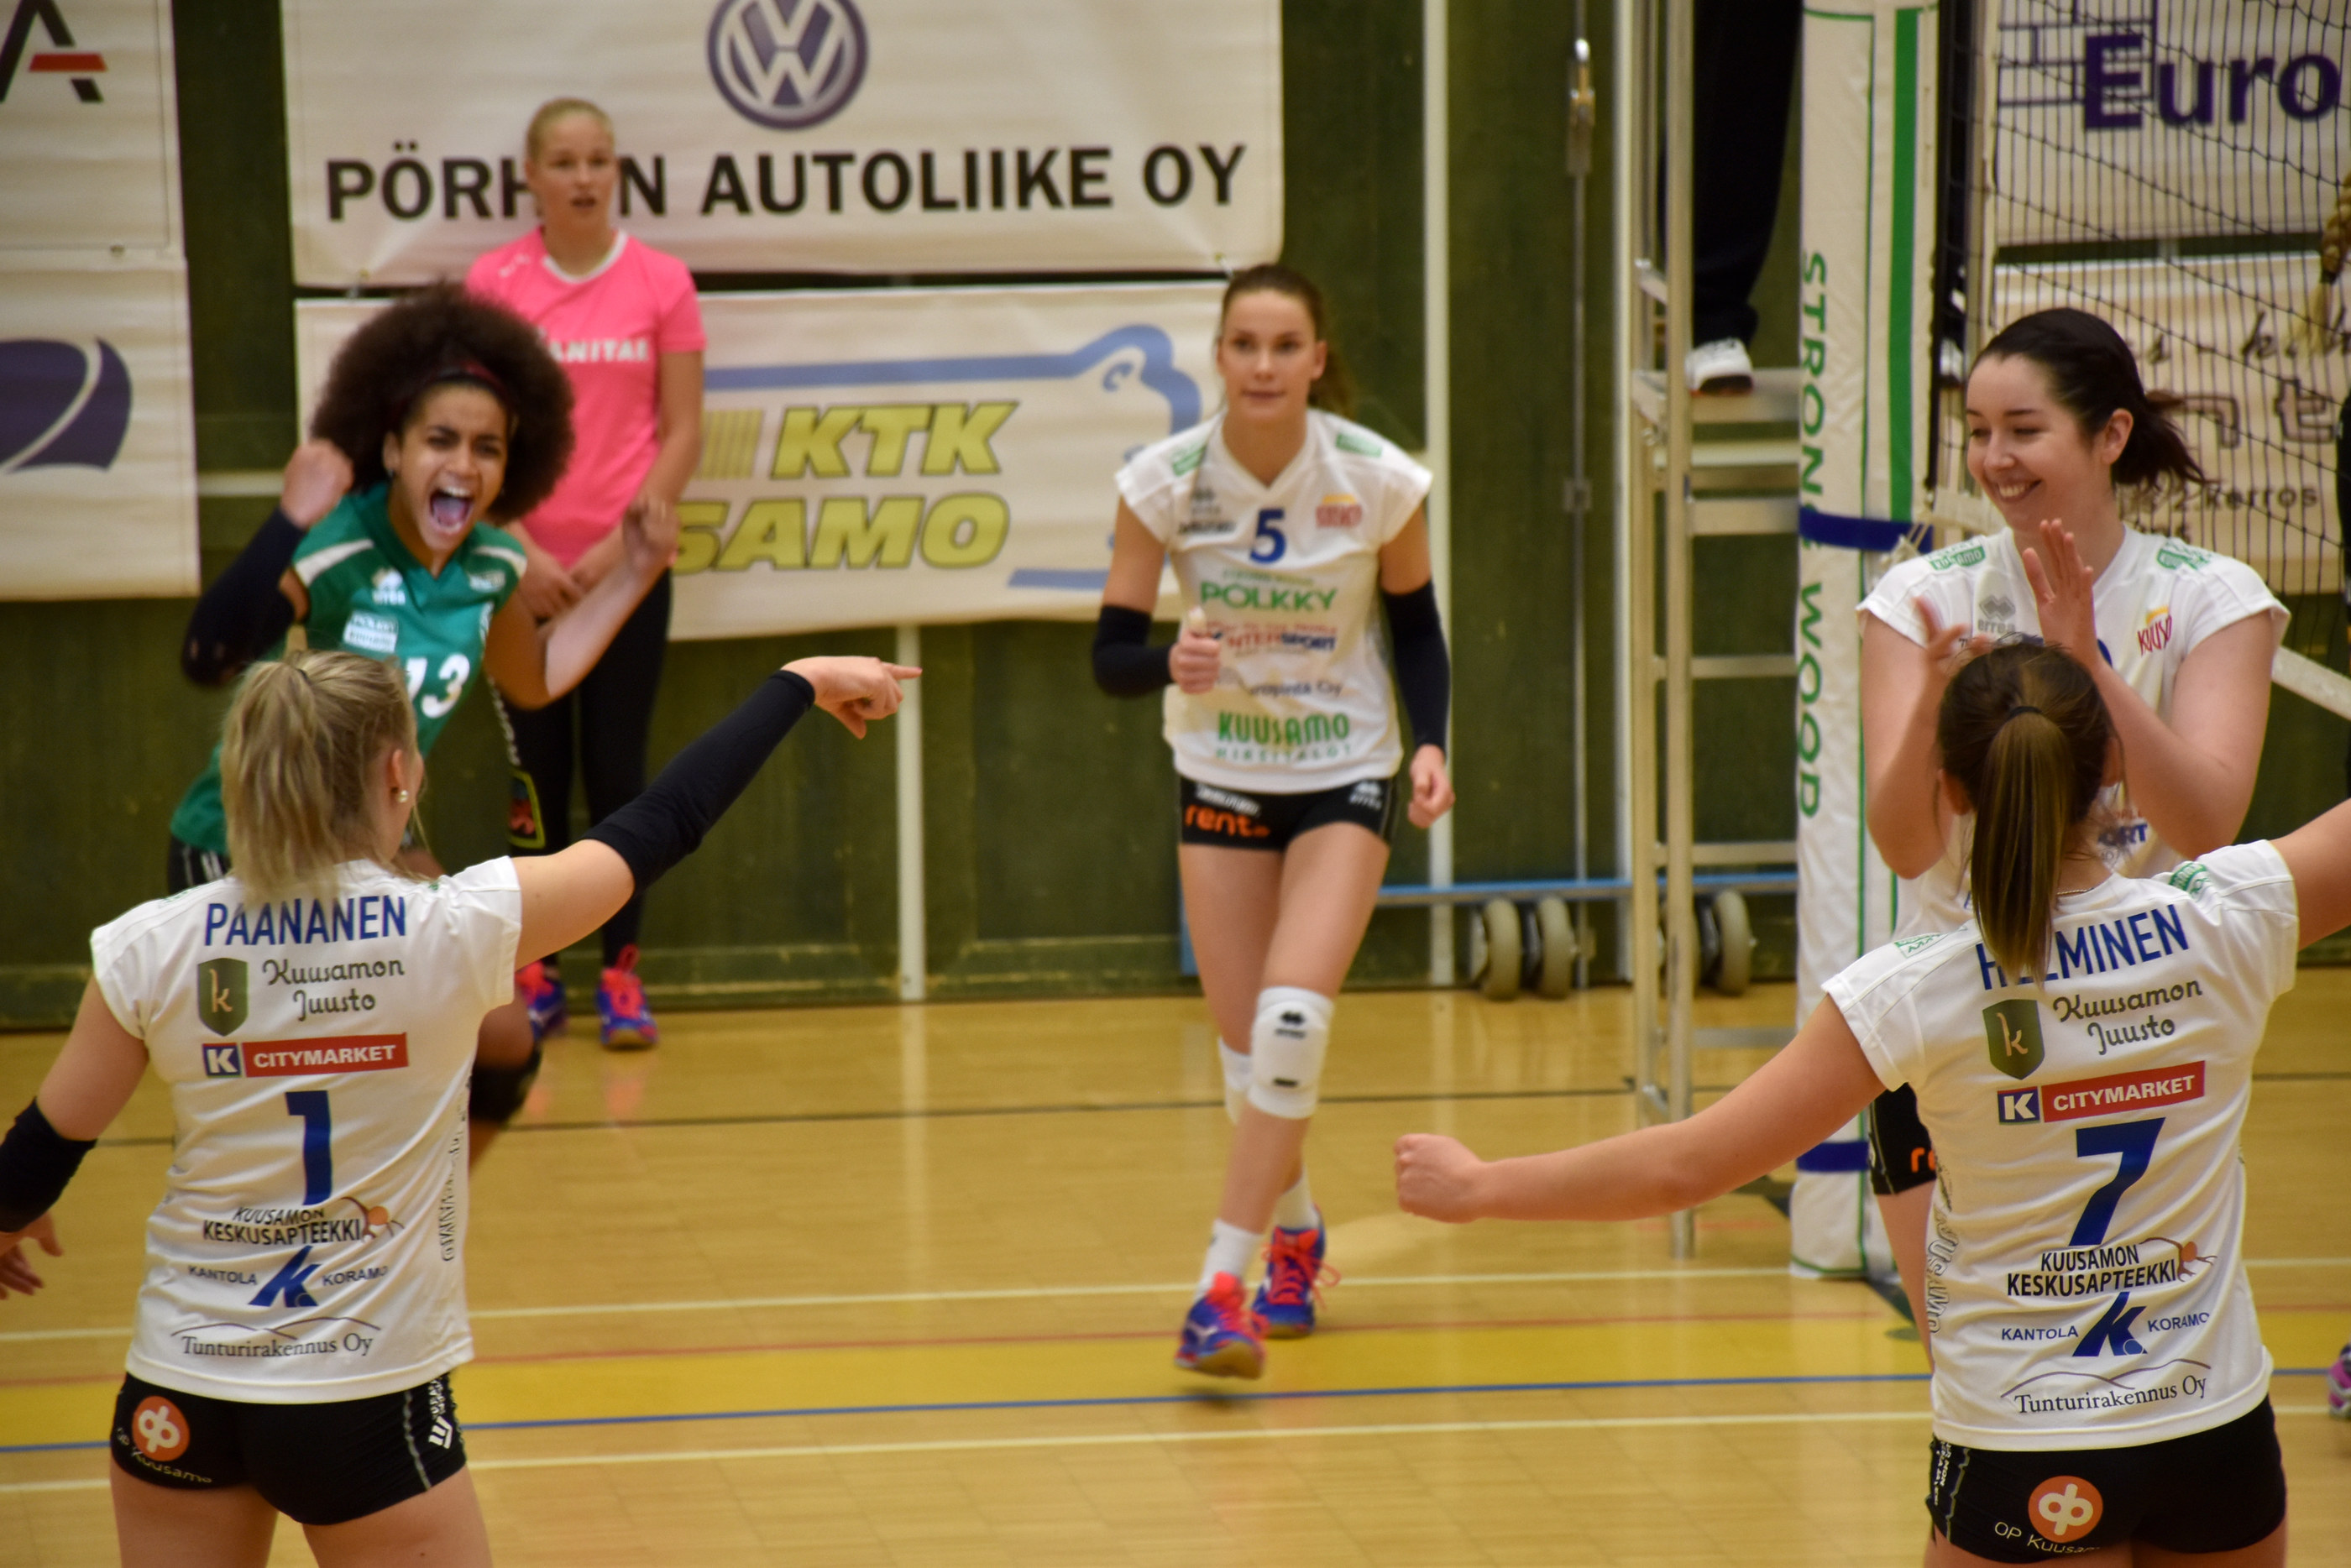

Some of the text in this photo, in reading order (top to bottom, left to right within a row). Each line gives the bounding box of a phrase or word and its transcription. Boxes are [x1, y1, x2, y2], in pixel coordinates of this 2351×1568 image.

[2084, 32, 2342, 131] Euro
[326, 140, 1247, 221] PÖRHN AUTOLIIKE OY
[770, 400, 1020, 480] KTK
[1249, 508, 1287, 564] 5
[406, 653, 471, 719] 13
[1797, 582, 1823, 818] WOOD
[1218, 712, 1350, 745] KUUSAMO
[204, 895, 406, 947] PAANANEN
[1976, 903, 2190, 990] HMINEN
[262, 958, 406, 986] Kuusamon
[292, 988, 377, 1022] Juusto
[2053, 979, 2203, 1023] Kuusamon
[2087, 1014, 2176, 1056] Juusto
[254, 1044, 397, 1069] CITYMARKET
[2053, 1074, 2196, 1111] CITYMARKET
[285, 1090, 332, 1206] 1
[2076, 1117, 2166, 1247] 7
[202, 1218, 361, 1246] KESKUSAPTEEKKI
[233, 1206, 326, 1227] KUUSAMON
[187, 1264, 259, 1286] KANTOLA
[322, 1265, 388, 1286] KORAMO
[2007, 1259, 2177, 1297] KESKUSAPTEEKKI
[2040, 1244, 2140, 1273] KUUSAMON
[181, 1332, 374, 1358] Tunturirakennus Oy
[2002, 1325, 2079, 1341] KANTOLA
[2148, 1311, 2210, 1334] KORAMO
[2015, 1373, 2207, 1414] Tunturirakennus Oy
[1994, 1521, 2023, 1540] OP
